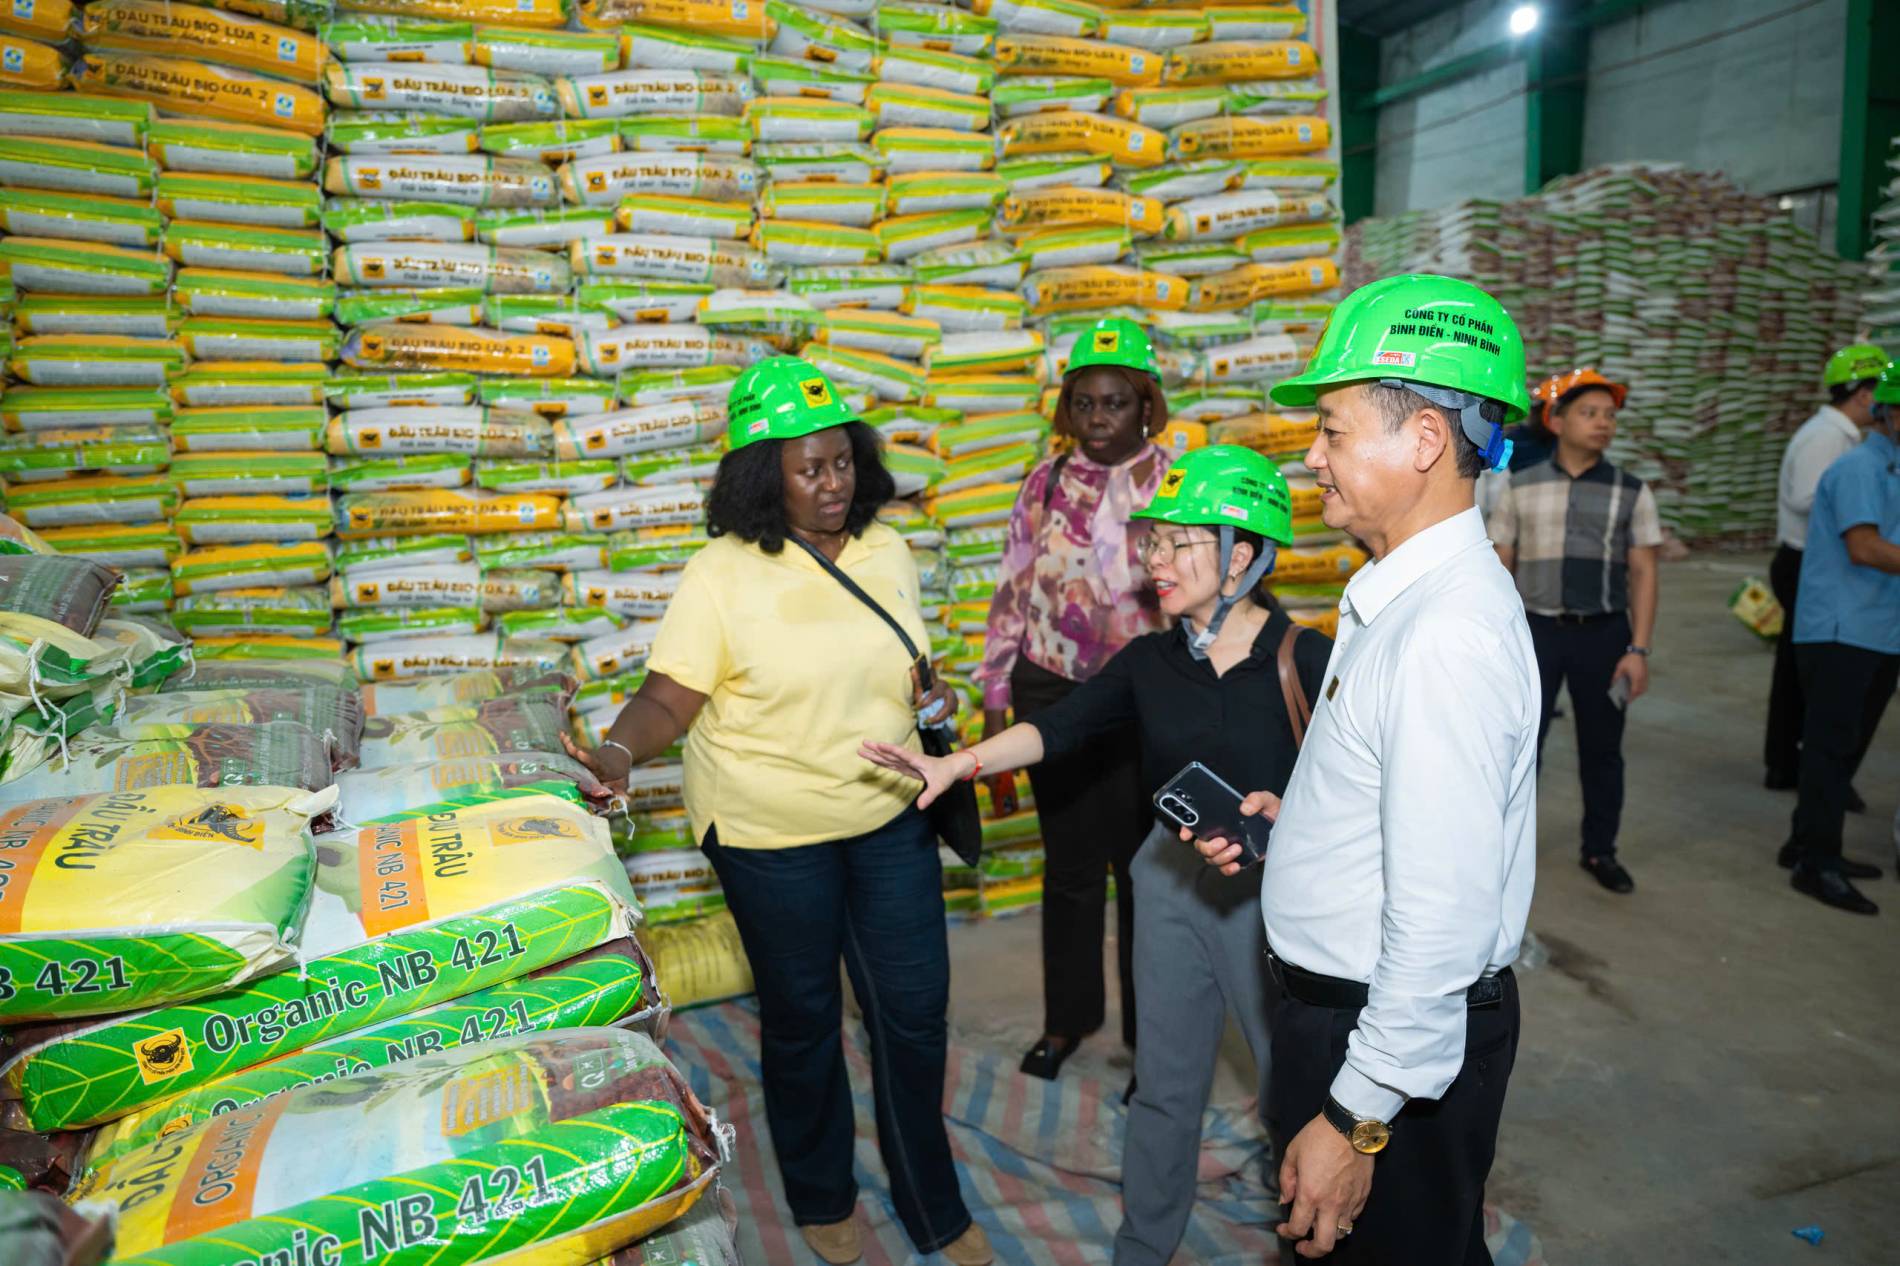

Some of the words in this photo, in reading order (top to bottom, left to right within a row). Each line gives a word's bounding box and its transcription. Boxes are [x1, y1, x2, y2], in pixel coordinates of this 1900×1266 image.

[1437, 311, 1449, 323] TY
[1453, 331, 1478, 347] NINH
[375, 850, 405, 877] NB
[431, 832, 475, 878] TRÂU
[378, 880, 411, 912] 421
[35, 956, 133, 997] 421
[203, 976, 368, 1054] Organic
[376, 949, 439, 998] NB
[451, 923, 527, 973] 421
[385, 1029, 445, 1064] NB
[460, 1000, 537, 1046] 421
[360, 1194, 437, 1258] NB
[457, 1155, 556, 1223] 421
